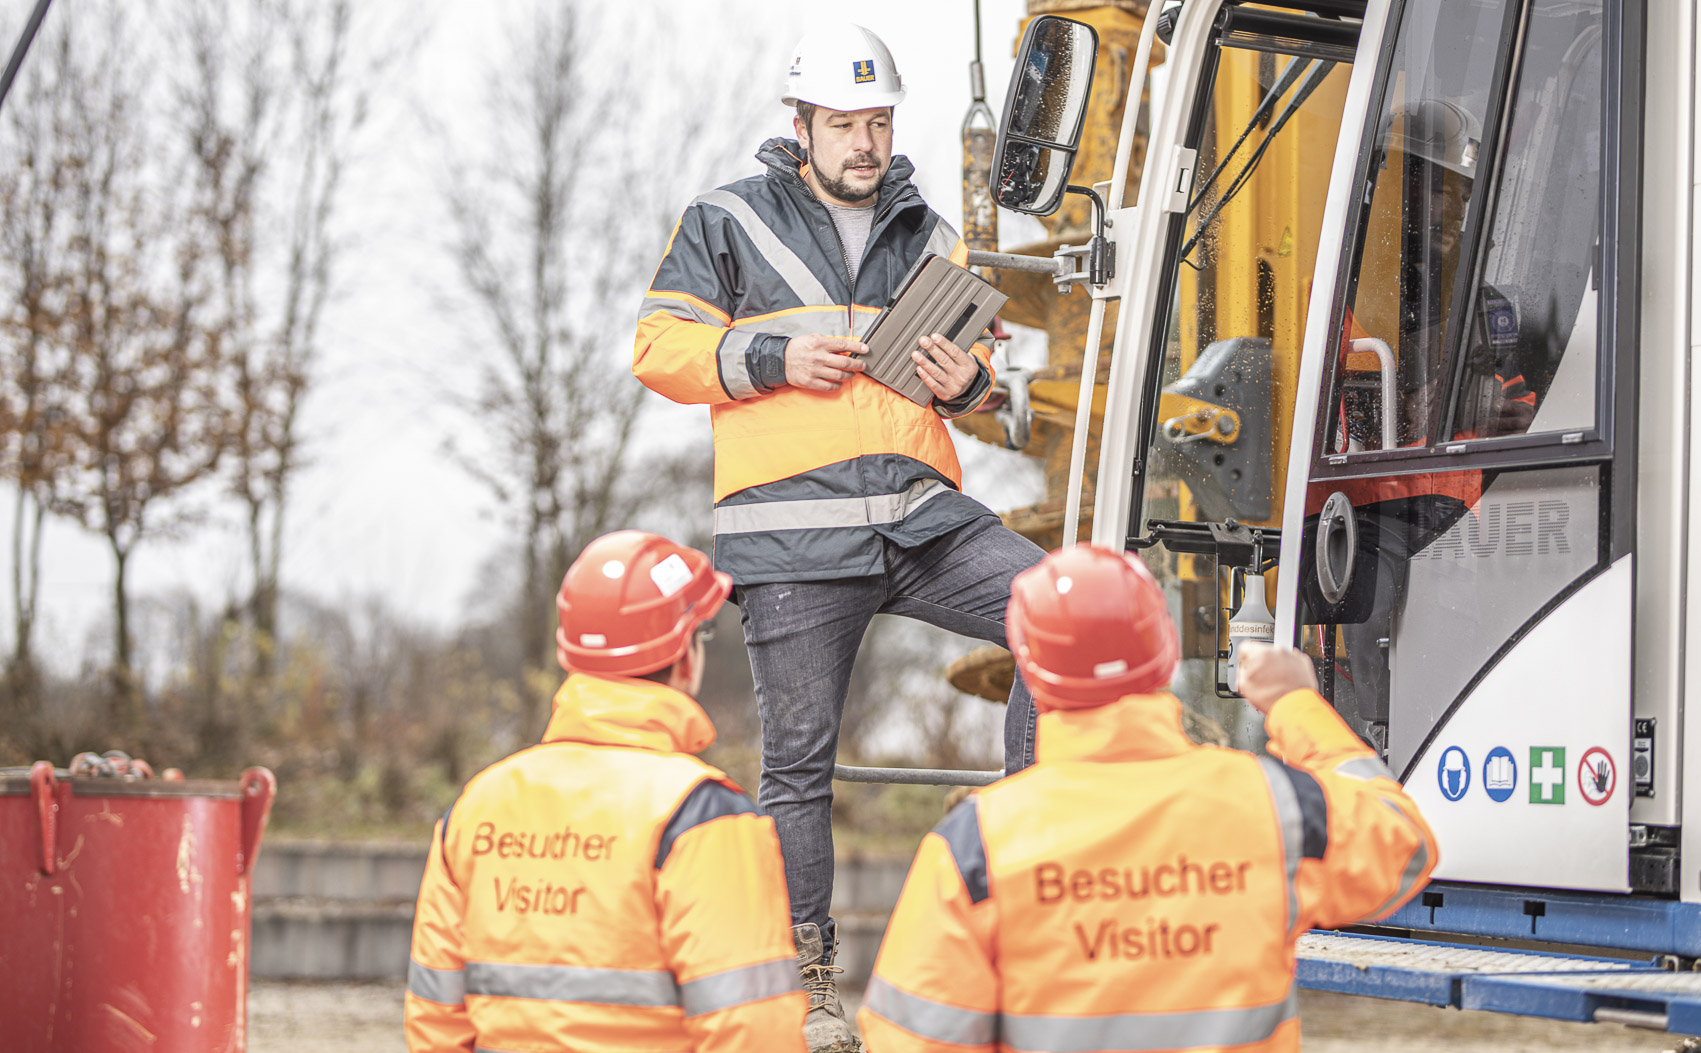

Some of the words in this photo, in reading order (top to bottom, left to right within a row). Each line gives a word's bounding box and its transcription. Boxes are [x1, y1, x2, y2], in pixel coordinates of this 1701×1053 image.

[472, 821, 618, 861] Besucher
[494, 876, 587, 916] Visitor
[1033, 855, 1253, 906] Besucher
[1073, 917, 1221, 963] Visitor
